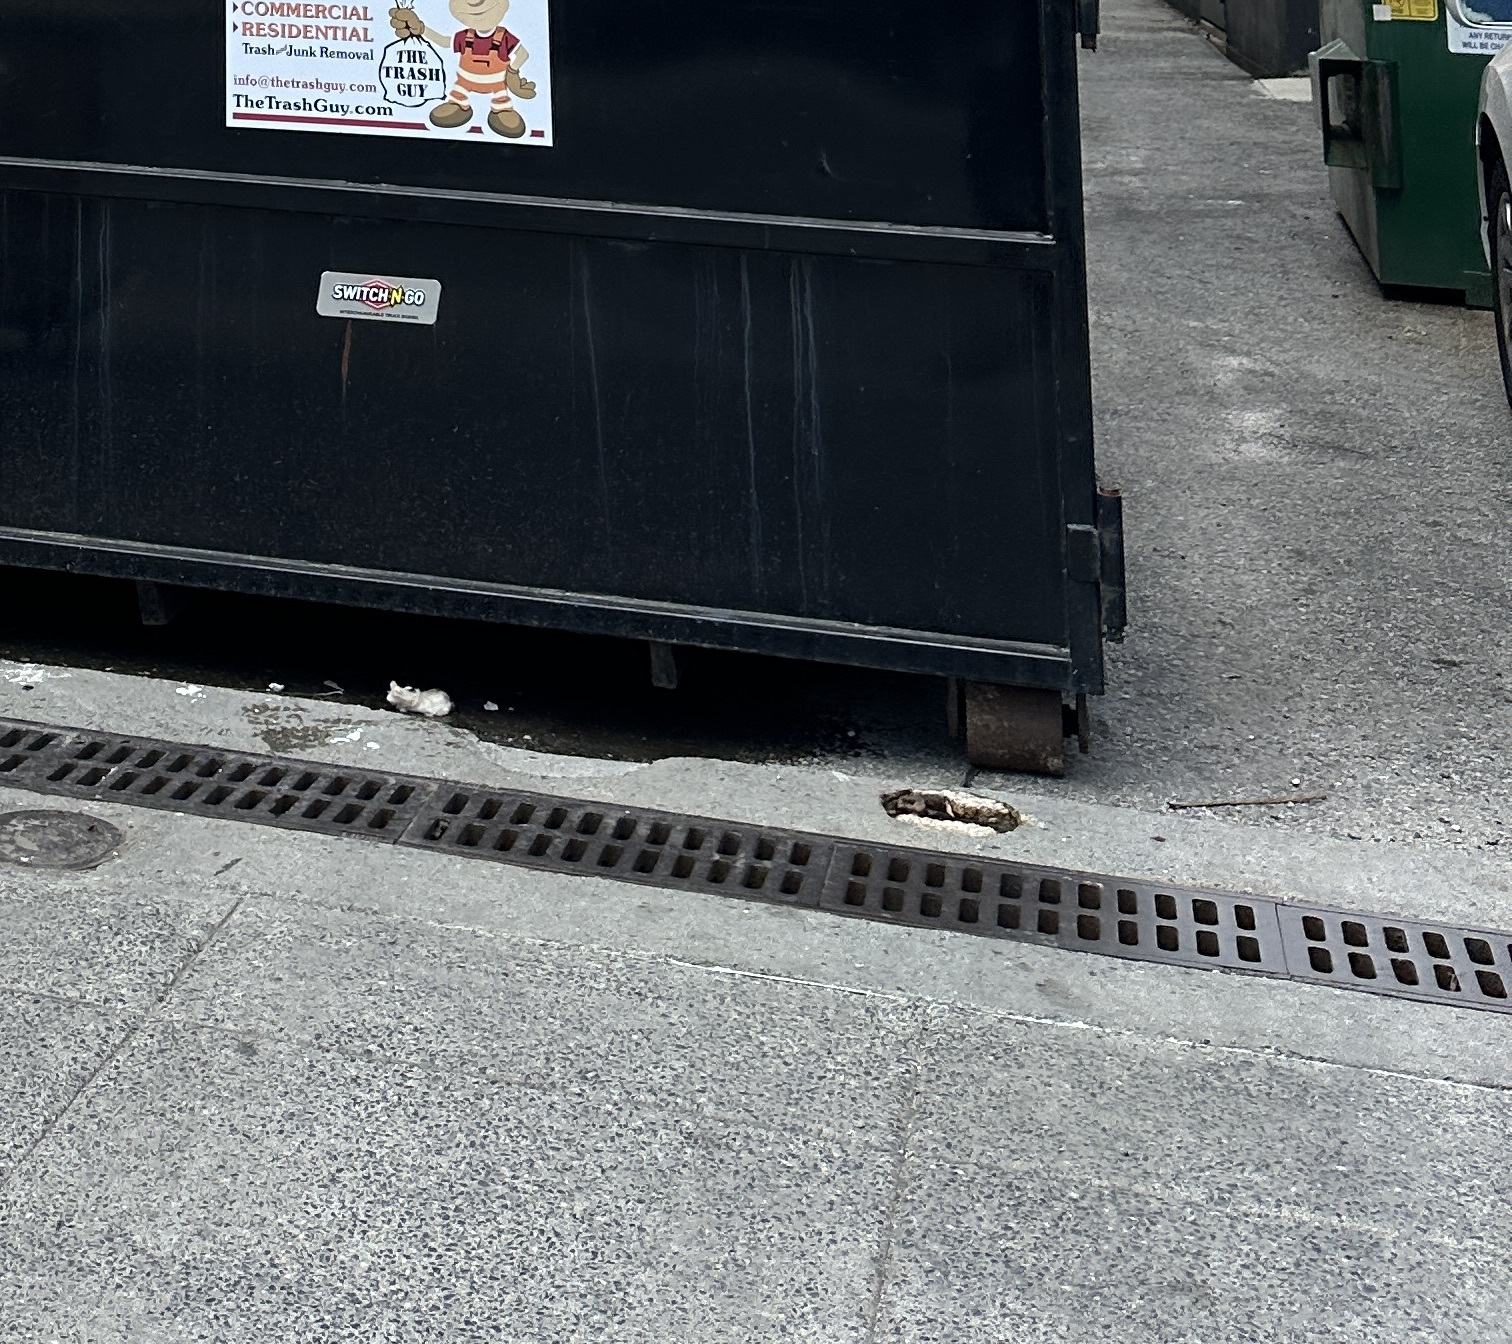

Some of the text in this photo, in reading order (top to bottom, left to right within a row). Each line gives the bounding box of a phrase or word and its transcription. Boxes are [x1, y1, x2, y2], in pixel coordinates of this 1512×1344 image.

[241, 0, 374, 21] COMMERCIAL
[241, 21, 374, 42] RESIDENTIAL
[242, 43, 275, 55] Trash
[286, 45, 317, 57] Junk
[320, 46, 374, 60] Removal
[396, 50, 428, 65] THE
[381, 65, 440, 82] TRASH
[233, 74, 377, 93] info@thetrashguy.com
[396, 82, 429, 99] GUY
[233, 93, 393, 118] TheTrashGuy.com
